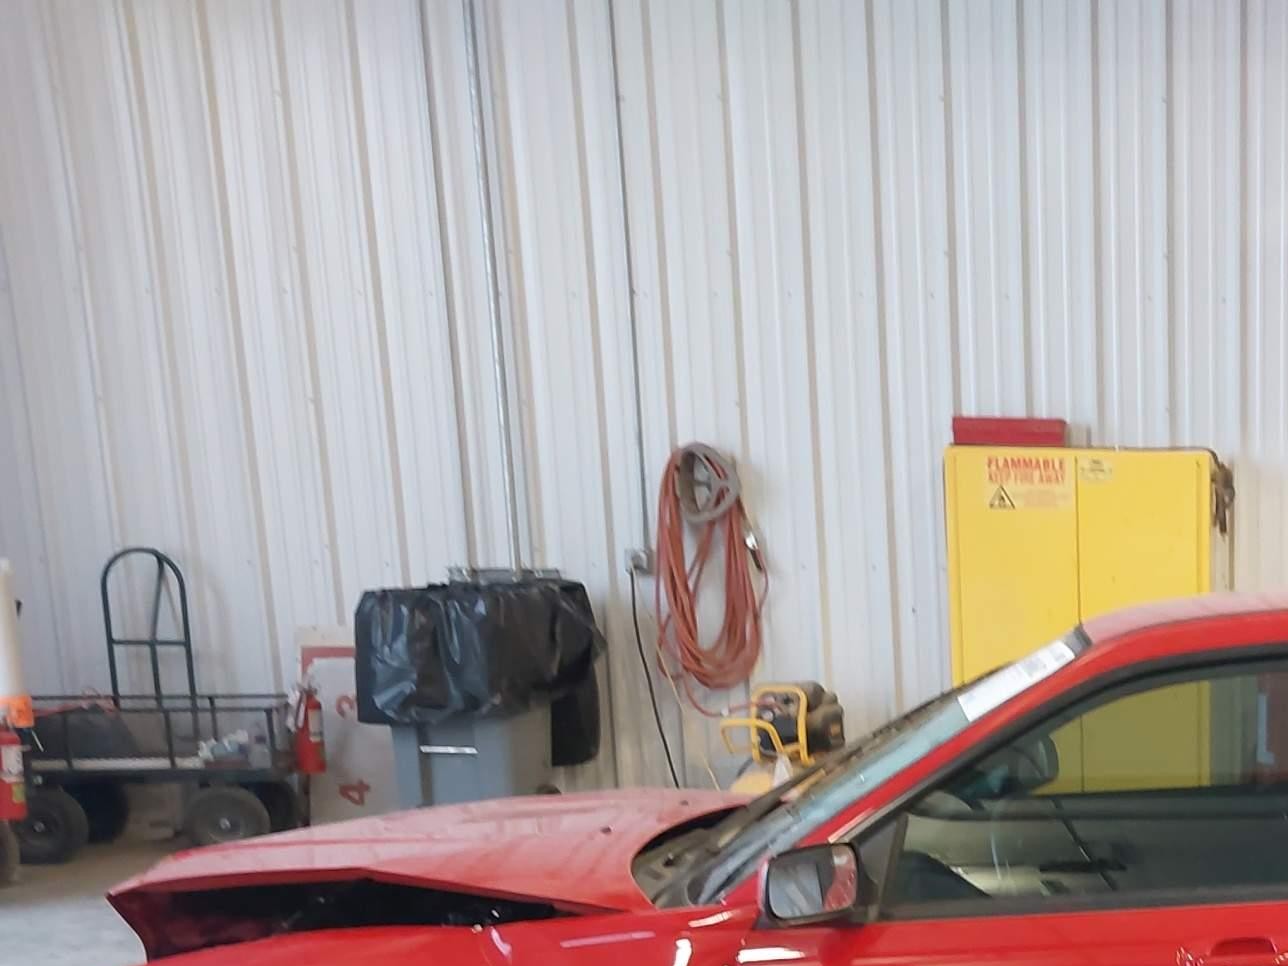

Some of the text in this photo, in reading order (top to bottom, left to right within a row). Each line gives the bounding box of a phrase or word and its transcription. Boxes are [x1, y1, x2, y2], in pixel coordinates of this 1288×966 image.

[987, 456, 1065, 470] FLAMMABLE
[988, 470, 1011, 484] KEEP
[1038, 470, 1065, 484] AWAY
